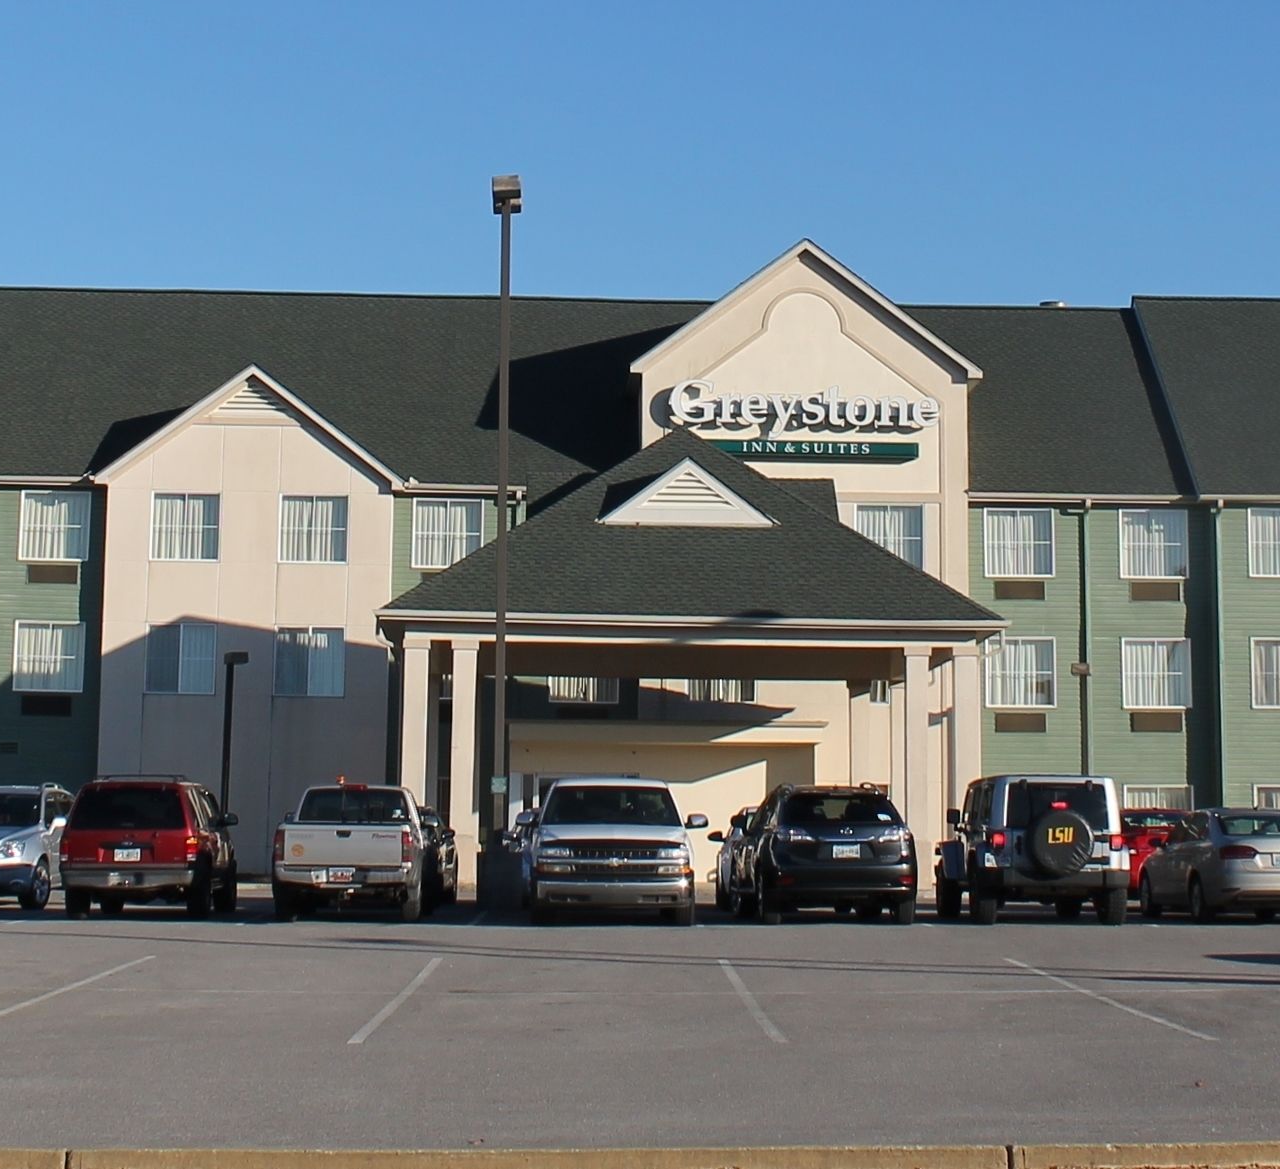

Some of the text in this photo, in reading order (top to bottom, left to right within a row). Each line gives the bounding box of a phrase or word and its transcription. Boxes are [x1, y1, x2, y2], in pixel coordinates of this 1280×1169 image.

[669, 379, 941, 440] Greystone
[742, 440, 871, 455] INN & SUITES
[1048, 826, 1074, 844] LSU
